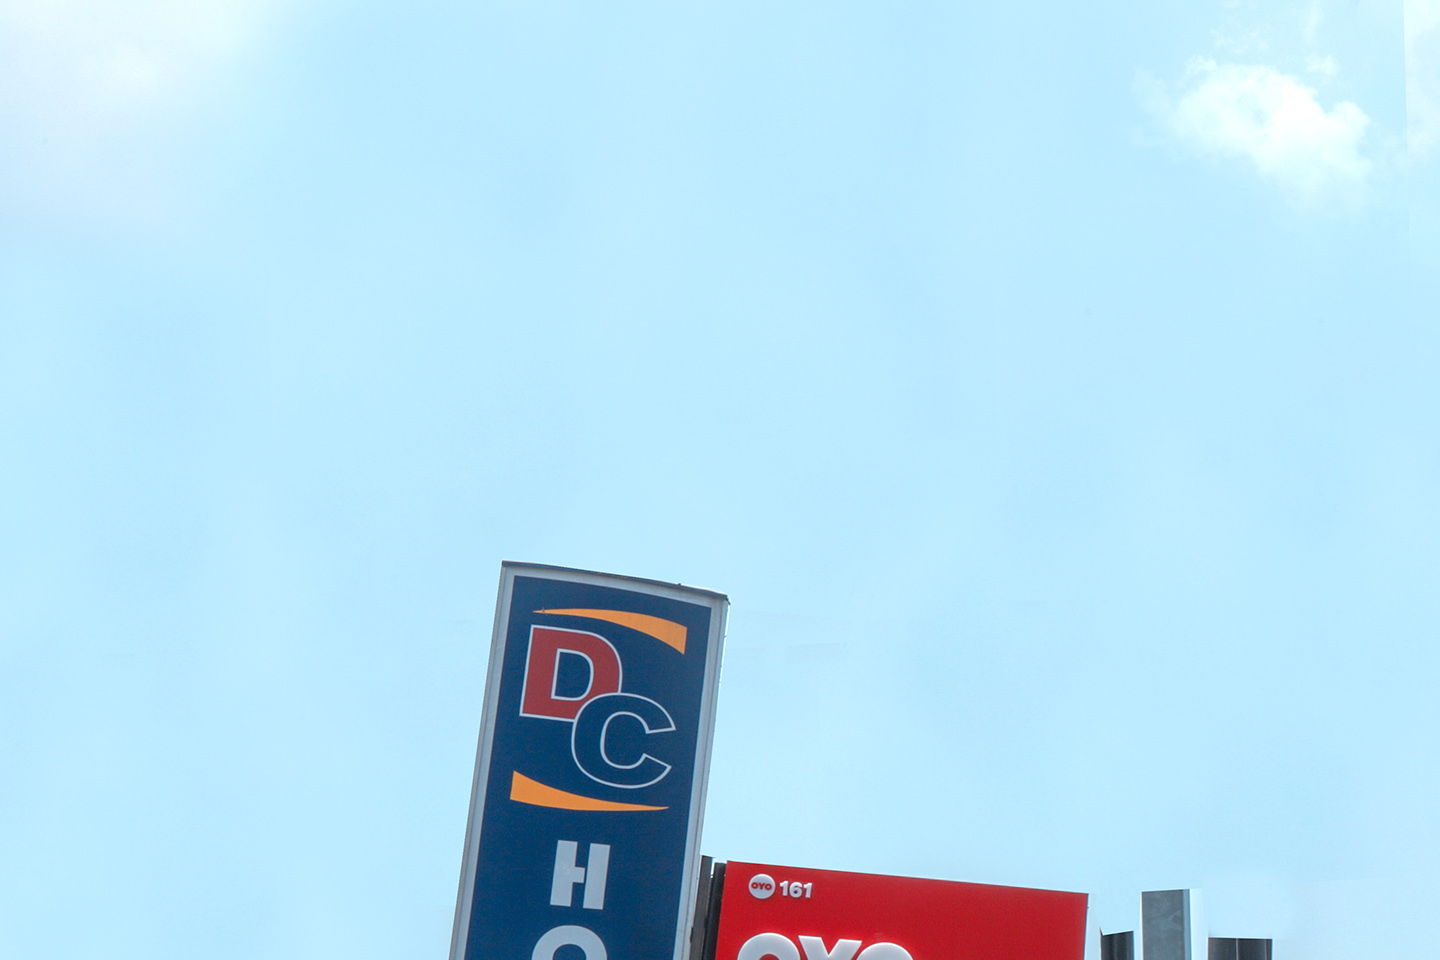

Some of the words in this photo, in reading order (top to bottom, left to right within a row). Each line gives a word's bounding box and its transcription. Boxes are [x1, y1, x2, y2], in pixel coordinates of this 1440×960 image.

[519, 623, 677, 790] DC
[751, 882, 772, 890] OYO
[779, 880, 813, 899] 161
